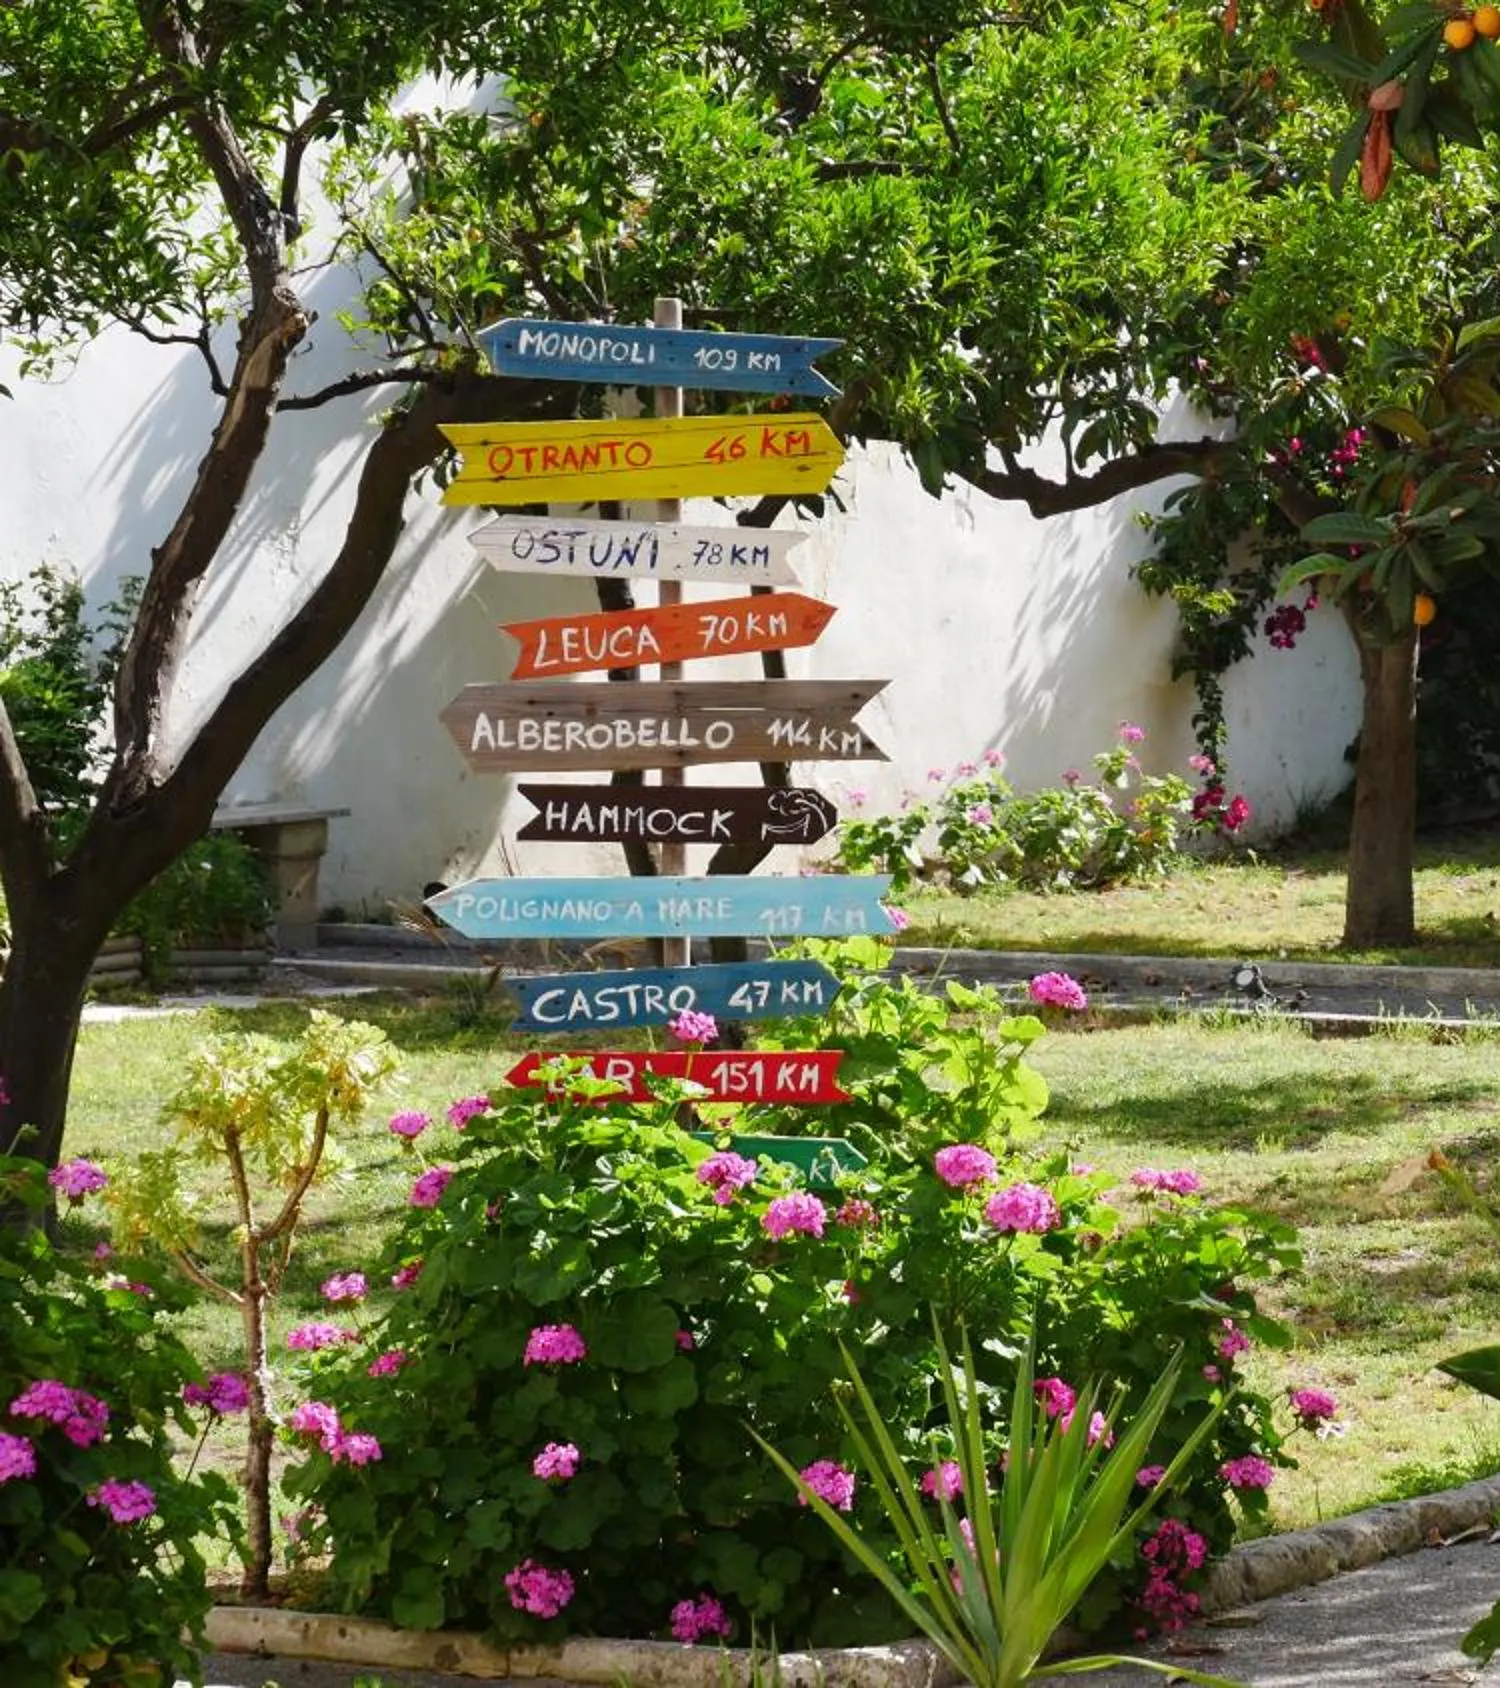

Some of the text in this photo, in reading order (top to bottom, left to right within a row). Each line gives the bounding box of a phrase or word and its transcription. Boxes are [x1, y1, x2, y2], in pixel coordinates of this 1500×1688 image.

[517, 329, 782, 371] MONOPOLI 109 KM
[487, 427, 811, 478] OTRANTO 46 KM
[511, 530, 769, 569] OSTUNI 78 KM
[532, 611, 788, 670] LEUCA 70 KM
[471, 712, 862, 757] ALBEROBELLO 114 KM
[545, 801, 735, 838] HAMMOCK
[455, 894, 866, 933] POLIGNANO A MARE 117 KM
[531, 979, 823, 1024] CASTRO 47 KM
[711, 1063, 764, 1096] 151
[777, 1063, 821, 1095] KM
